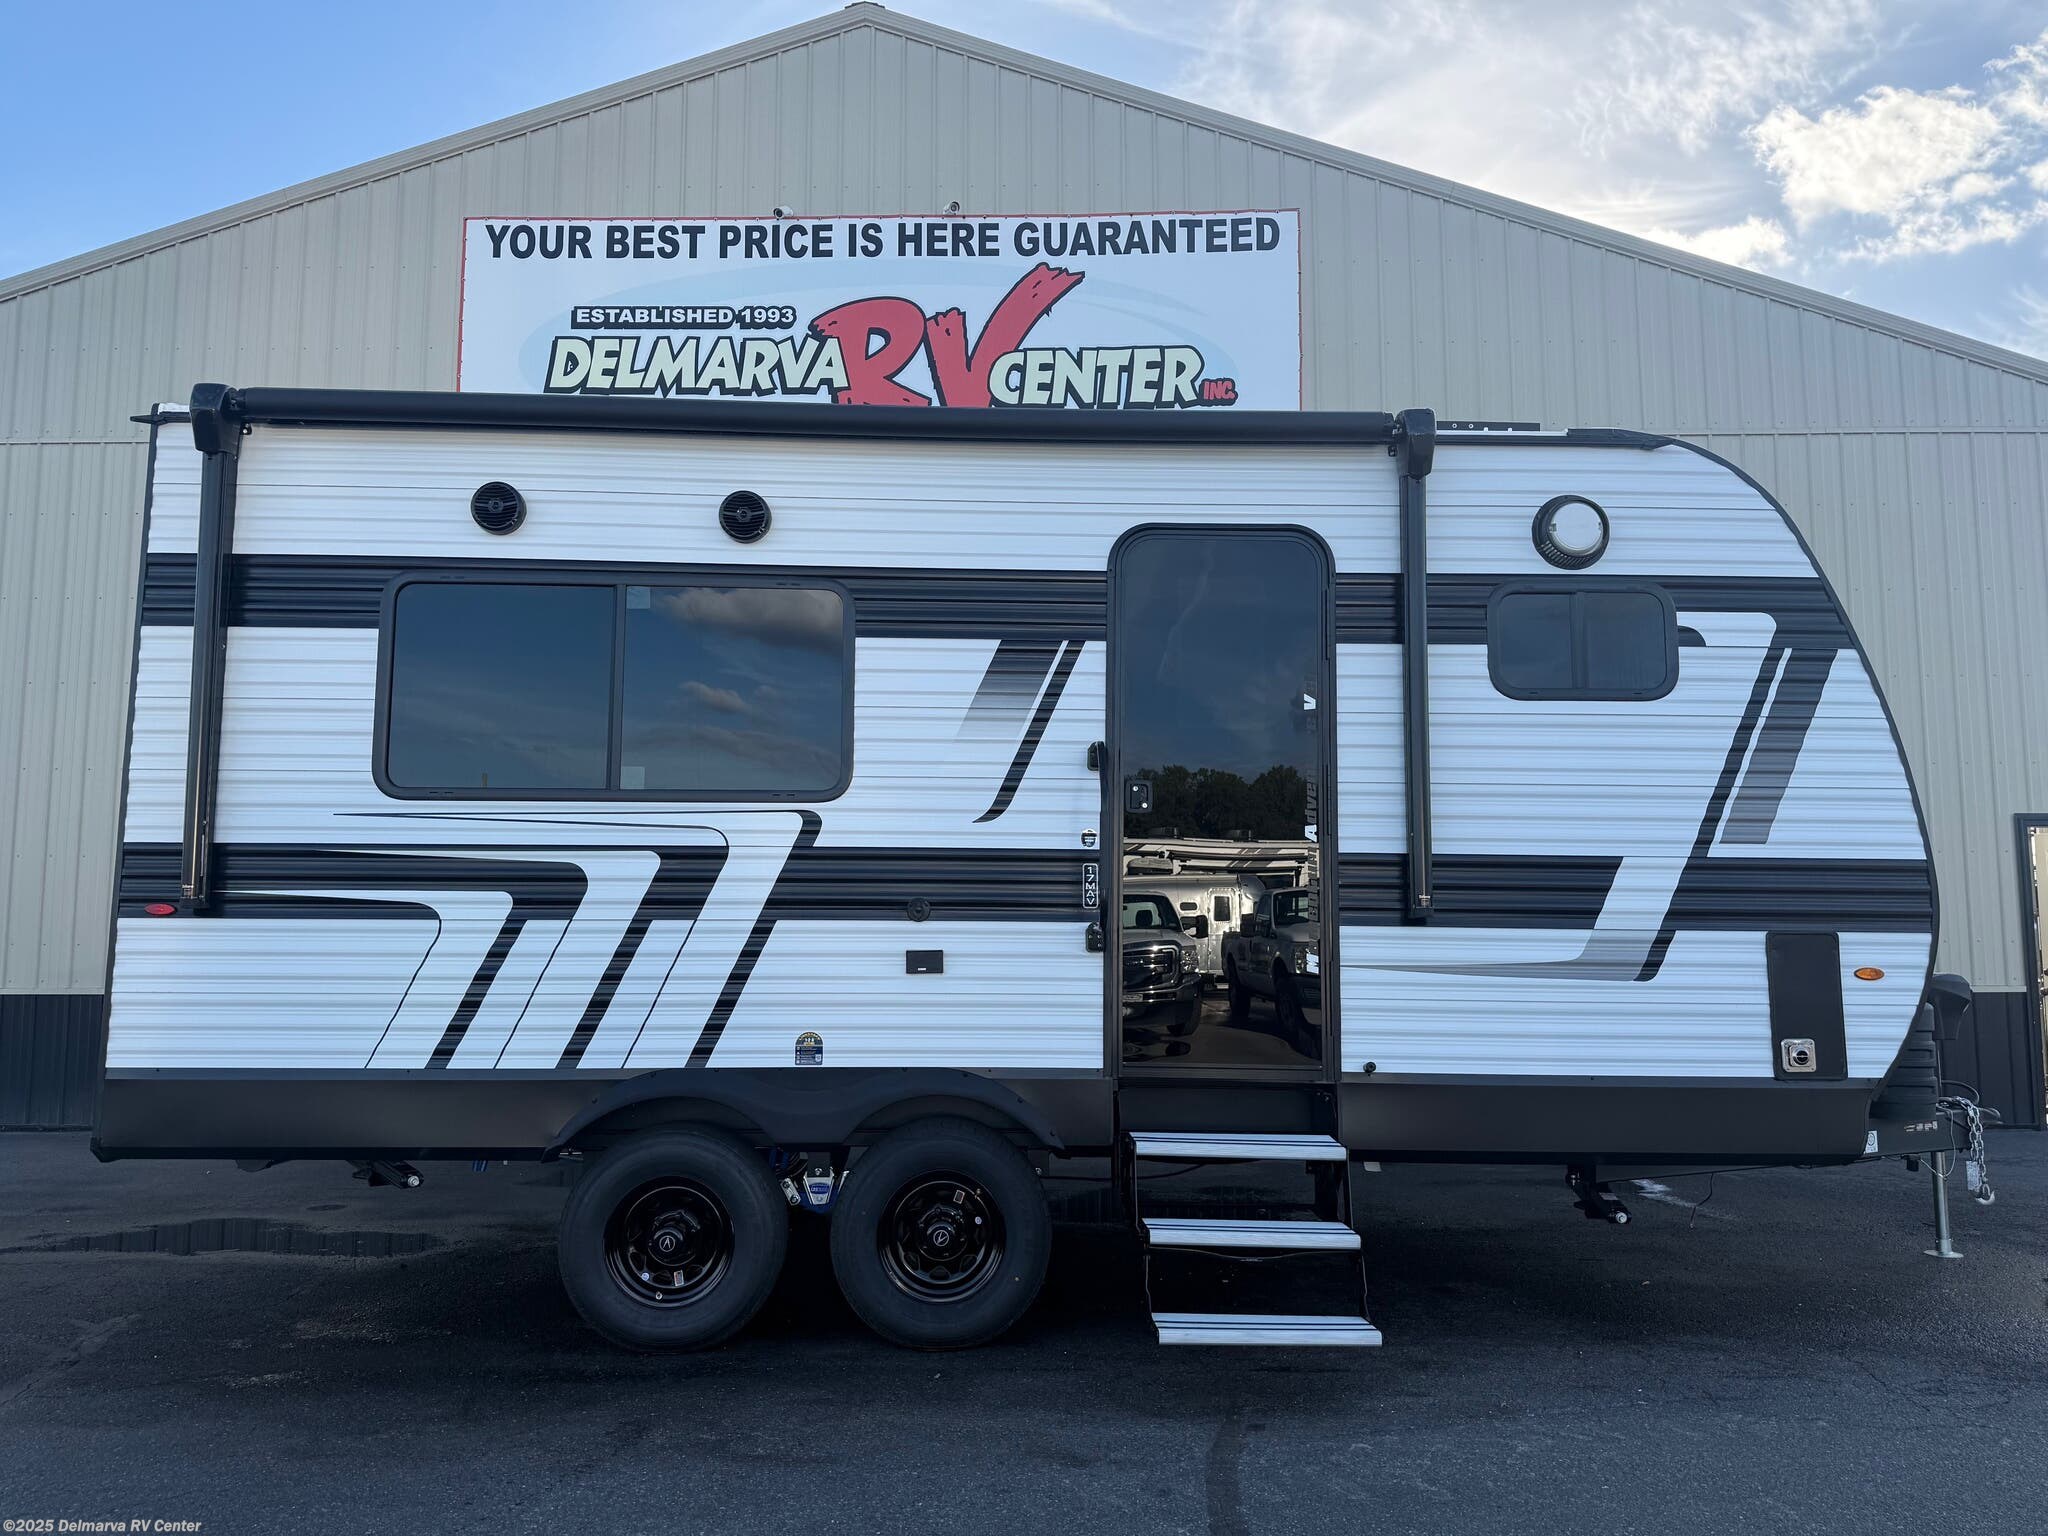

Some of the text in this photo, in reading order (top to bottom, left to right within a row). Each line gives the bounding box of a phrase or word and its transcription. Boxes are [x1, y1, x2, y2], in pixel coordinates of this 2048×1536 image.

[485, 217, 1281, 260] YOUR BEST PRICE IS HERE GUARANTEED
[546, 335, 850, 395] DELMARVA
[808, 262, 1086, 408] RV
[988, 345, 1205, 407] CENTER
[575, 308, 795, 324] ESTABLISHED 1993
[1085, 866, 1096, 905] 17MAV
